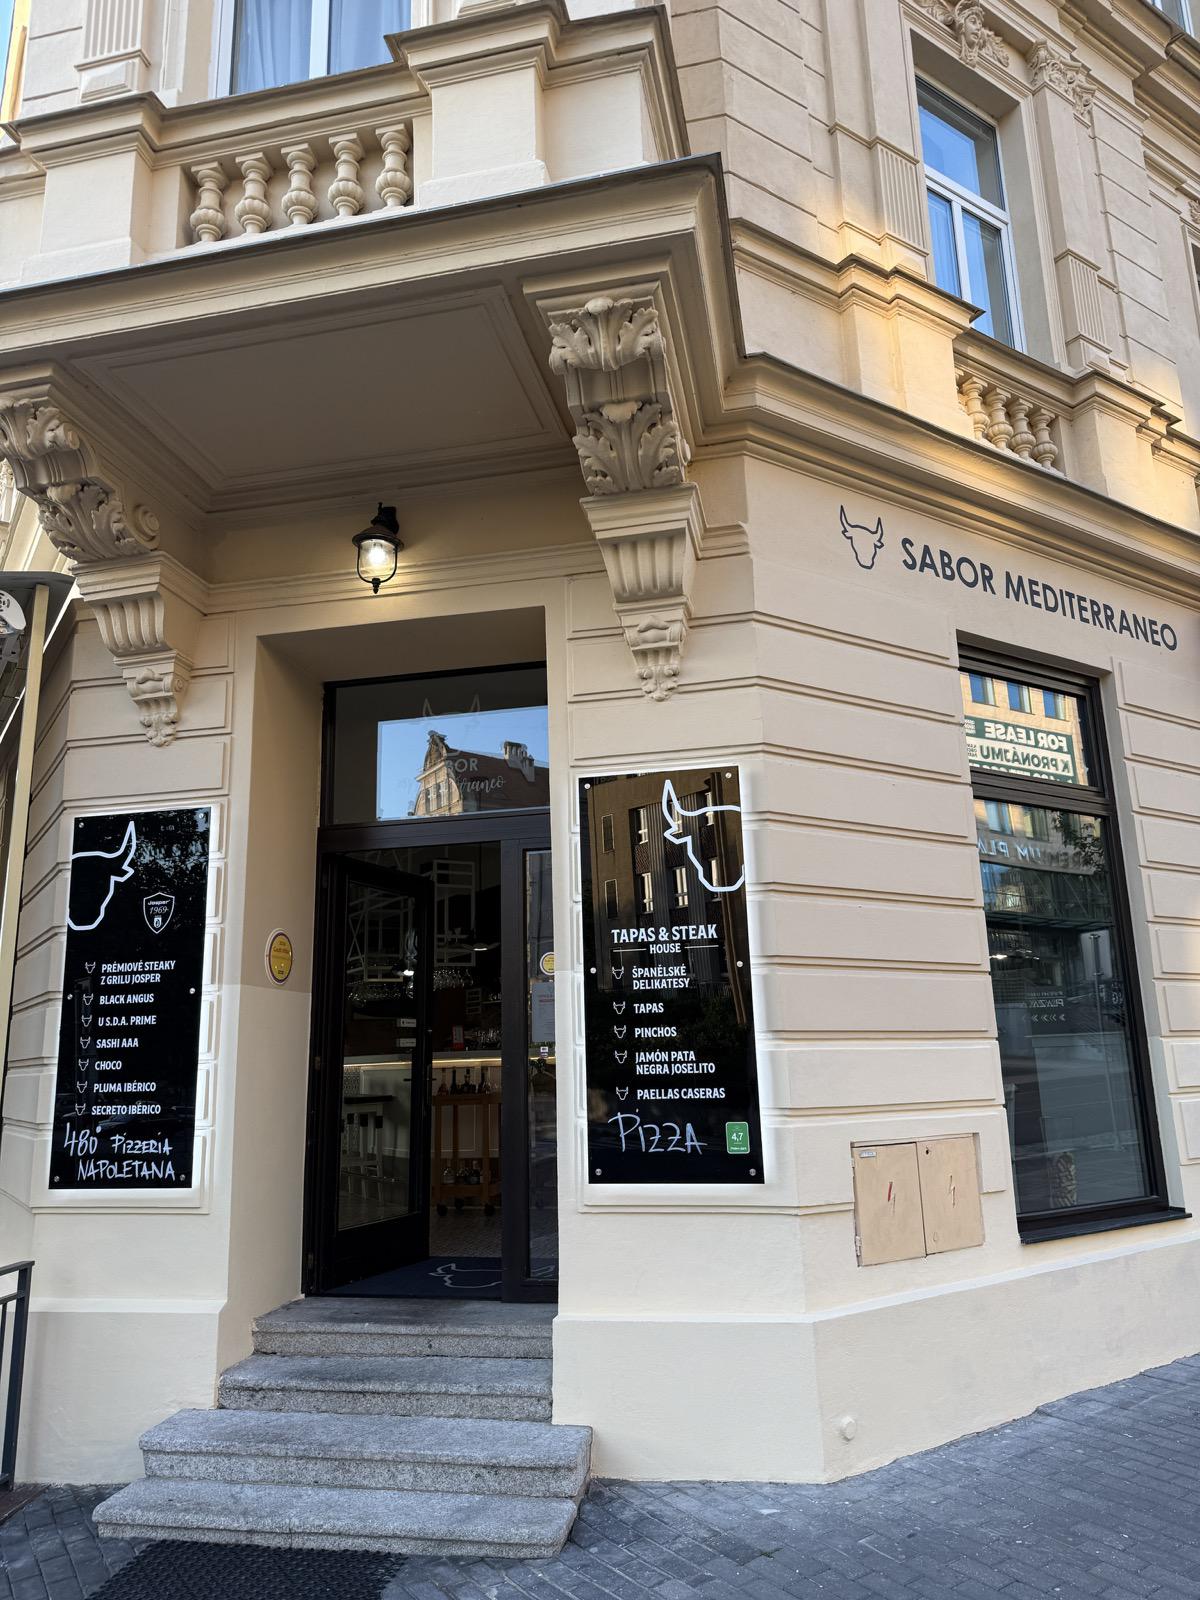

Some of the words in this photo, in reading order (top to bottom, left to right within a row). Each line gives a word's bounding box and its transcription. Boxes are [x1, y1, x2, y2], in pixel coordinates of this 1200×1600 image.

[900, 537, 996, 595] SABOR
[1005, 570, 1178, 652] MEDITERRANEO
[149, 905, 169, 915] 1969
[611, 927, 656, 944] TAPAS
[658, 926, 670, 941] &
[671, 924, 718, 941] STEAK
[649, 943, 682, 954] HOUSE
[101, 960, 143, 974] PRÉMIOVÉ
[144, 960, 177, 971] STEAKY
[632, 963, 687, 978] ŠPANĚLSKÉ
[100, 976, 106, 985] Z
[106, 975, 131, 985] GRILU
[131, 973, 161, 984] JOSPER
[633, 978, 690, 990] DELIKATESY
[99, 994, 126, 1005] BLACK
[126, 993, 155, 1004] ANGUS
[633, 1002, 665, 1014] TAPAS
[130, 1015, 157, 1026] PRIME
[634, 1026, 677, 1038] PINCHOS
[96, 1038, 120, 1049] SASHI
[121, 1037, 139, 1048] AAA
[635, 1049, 669, 1064] JAMÓN
[671, 1050, 696, 1062] PATA
[94, 1060, 122, 1071] CHOCO
[636, 1064, 670, 1075] NEGRA
[671, 1063, 716, 1075] JOSELITO
[93, 1083, 122, 1093] PLUMA
[123, 1080, 157, 1092] IBÉRICO
[637, 1089, 680, 1100] PAELLAS
[681, 1087, 726, 1099] CASERAS
[91, 1105, 128, 1116] SECRETO
[128, 1102, 162, 1114] IBÉRICO
[731, 1132, 744, 1142] 4,7
[78, 1158, 176, 1181] NAPOLETANA
